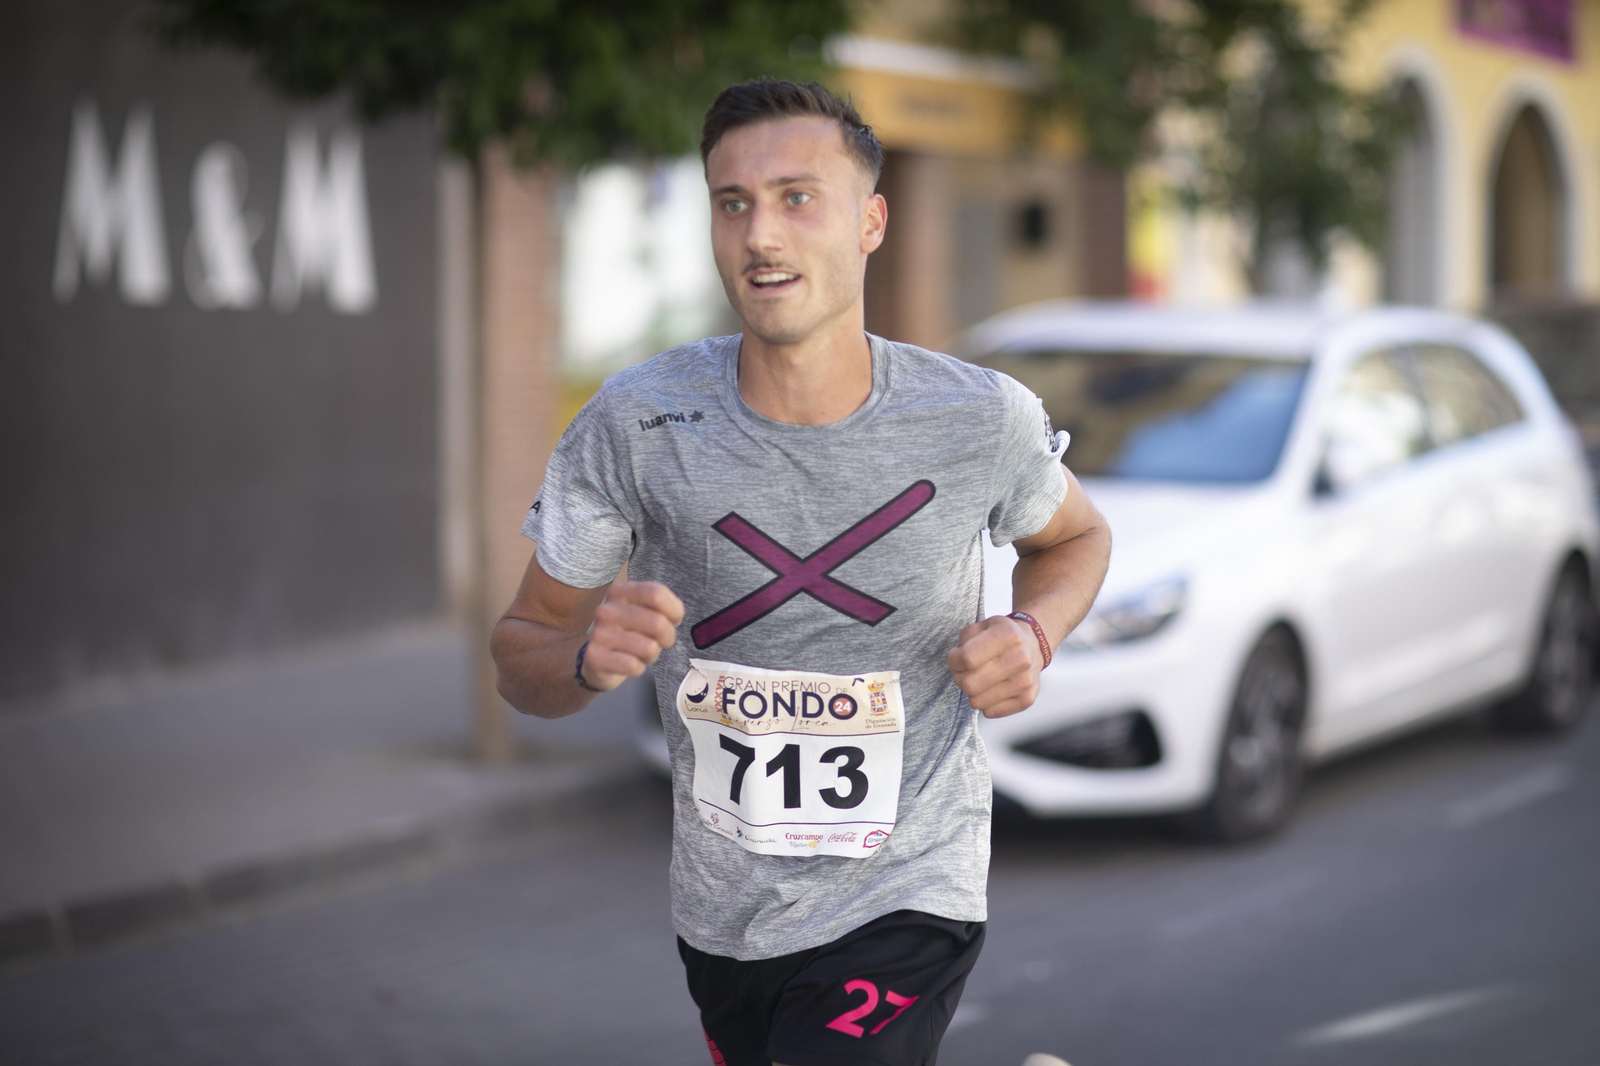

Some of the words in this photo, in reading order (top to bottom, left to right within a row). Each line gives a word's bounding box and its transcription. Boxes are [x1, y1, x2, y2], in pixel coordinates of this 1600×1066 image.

[638, 412, 686, 432] luanvi
[723, 676, 766, 693] GRAN
[772, 680, 831, 695] PREMIO
[835, 687, 848, 695] DE
[721, 688, 858, 720] FONDO
[834, 701, 852, 713] 24
[719, 733, 869, 809] 713
[785, 832, 824, 842] Cruzcampo
[825, 978, 920, 1038] 27
